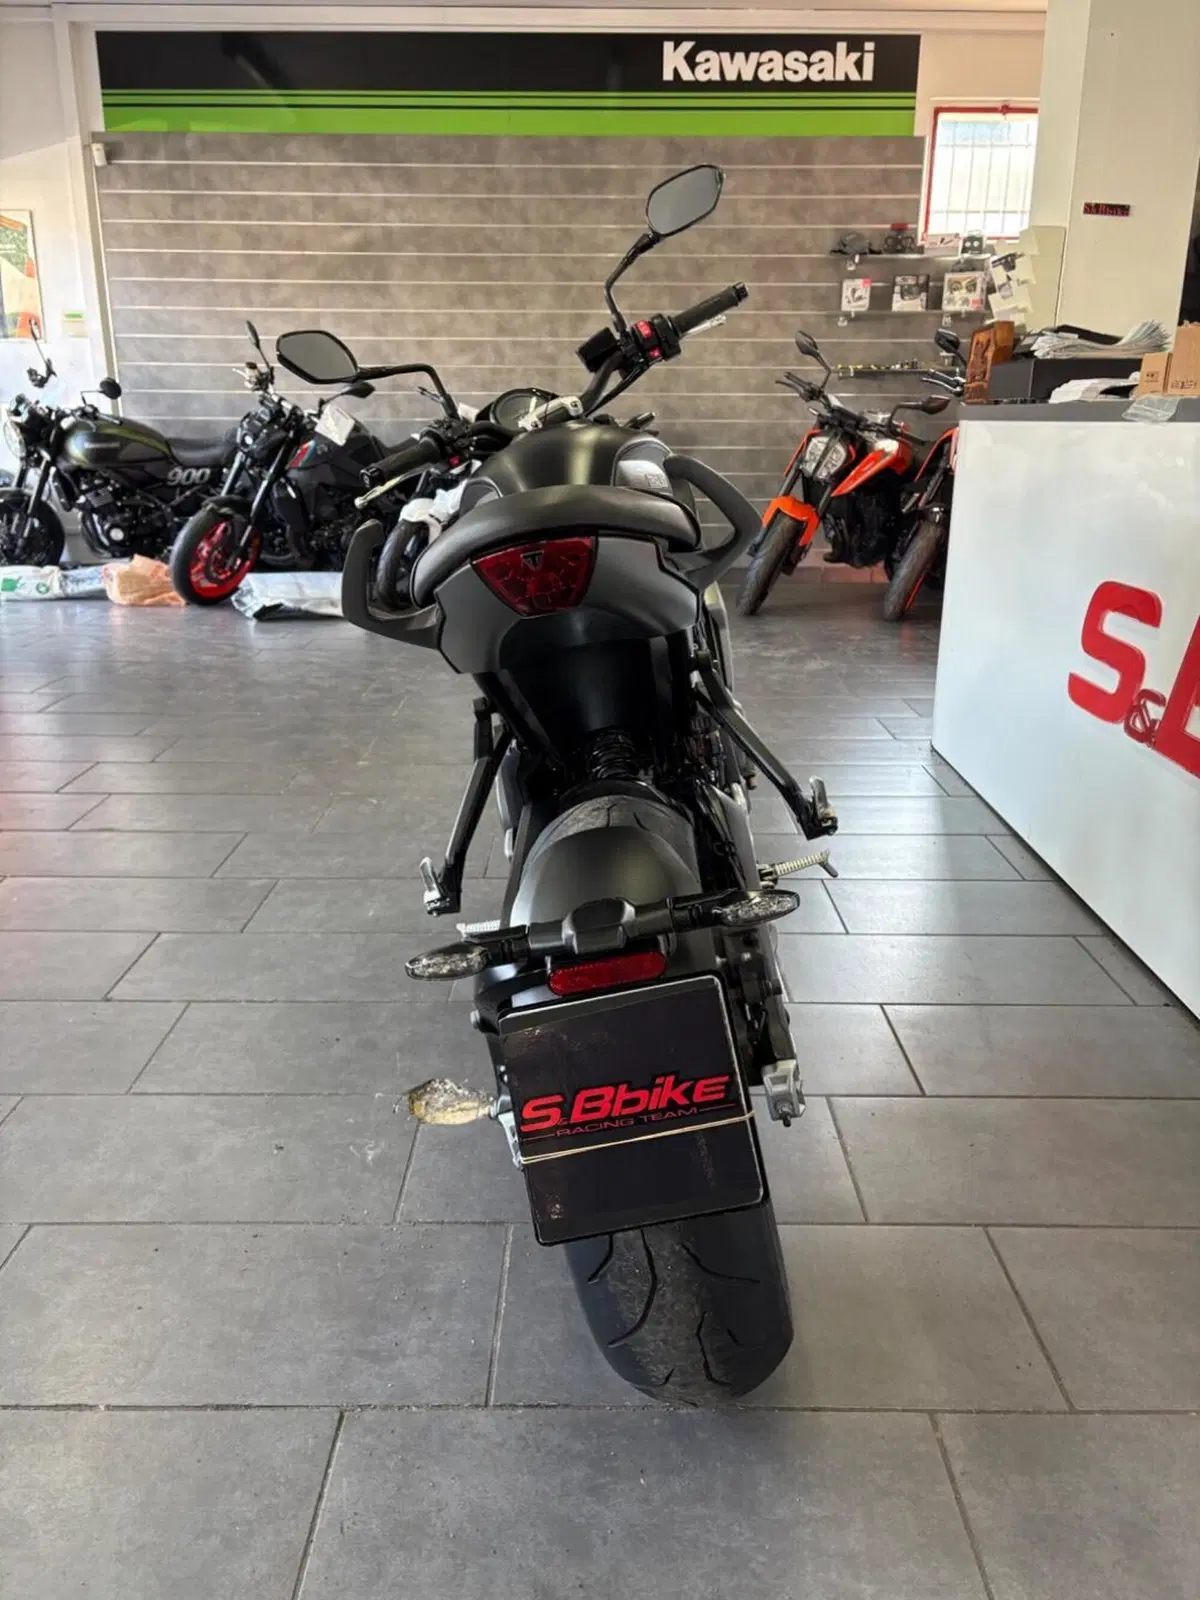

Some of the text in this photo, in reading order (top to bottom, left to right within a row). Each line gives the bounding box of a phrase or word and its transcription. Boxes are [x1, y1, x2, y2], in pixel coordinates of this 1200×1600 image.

[662, 41, 875, 82] Kawasaki
[166, 467, 211, 486] 900
[555, 1106, 698, 1137] RACING TEAM
